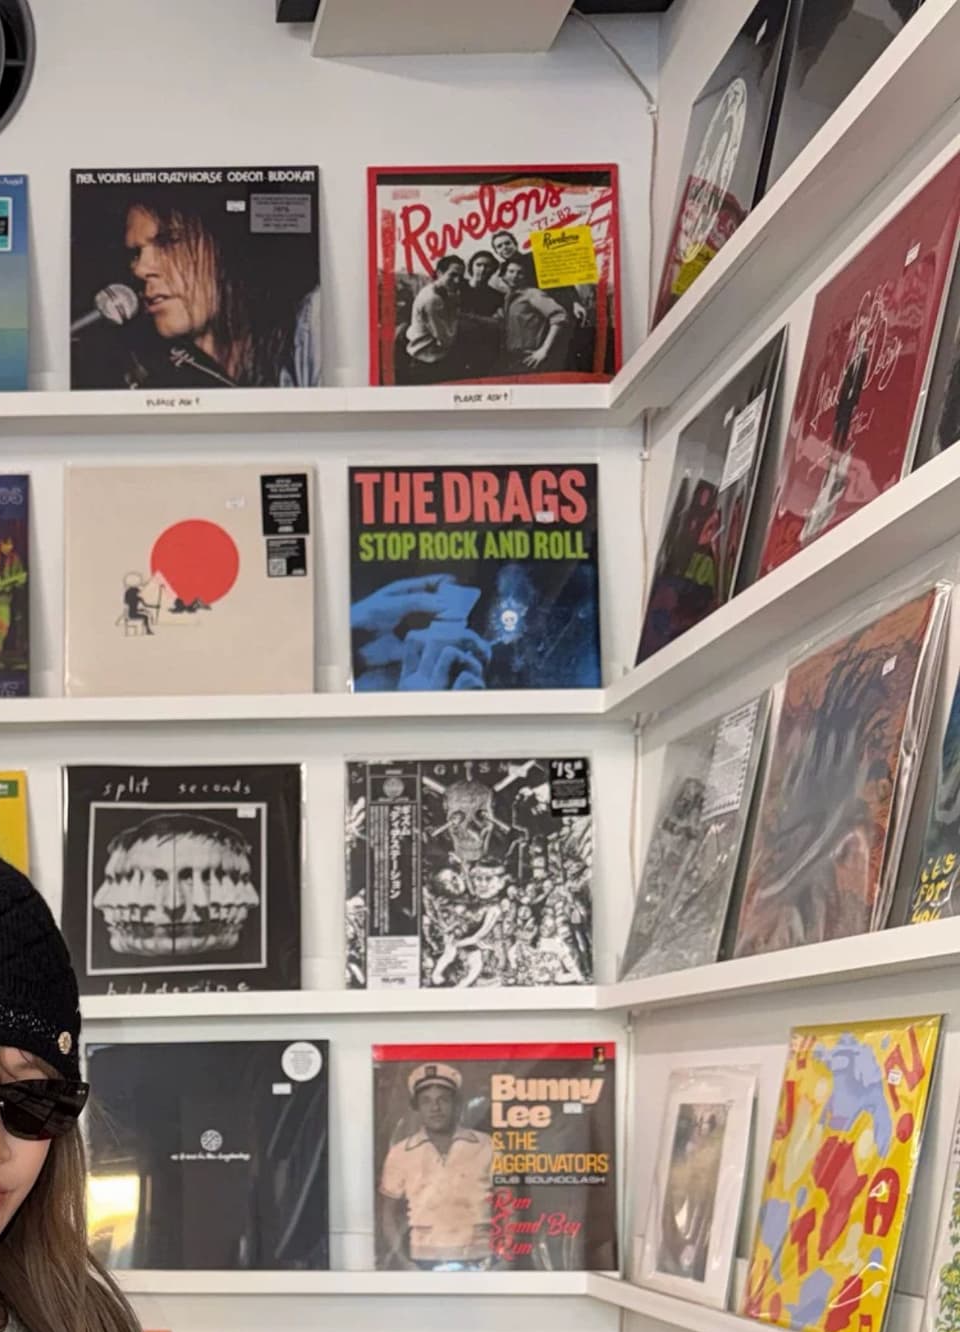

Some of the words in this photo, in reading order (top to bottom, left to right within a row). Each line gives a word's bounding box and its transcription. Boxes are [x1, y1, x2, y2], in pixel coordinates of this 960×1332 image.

[97, 172, 131, 184] YOUNG
[189, 170, 223, 182] HORSE
[400, 182, 564, 280] Revelons
[354, 472, 439, 525] THE
[443, 469, 588, 524] DRAGS
[359, 532, 417, 561] STOP
[419, 531, 480, 560] ROCK
[483, 530, 530, 559] AND
[533, 530, 588, 560] ROLL
[102, 776, 150, 800] split
[178, 779, 252, 796] seconds
[491, 1074, 604, 1104] Bunny
[491, 1102, 552, 1128] Lee
[492, 1132, 505, 1150] &
[507, 1132, 538, 1150] THE
[492, 1153, 608, 1174] AGGROVATORS
